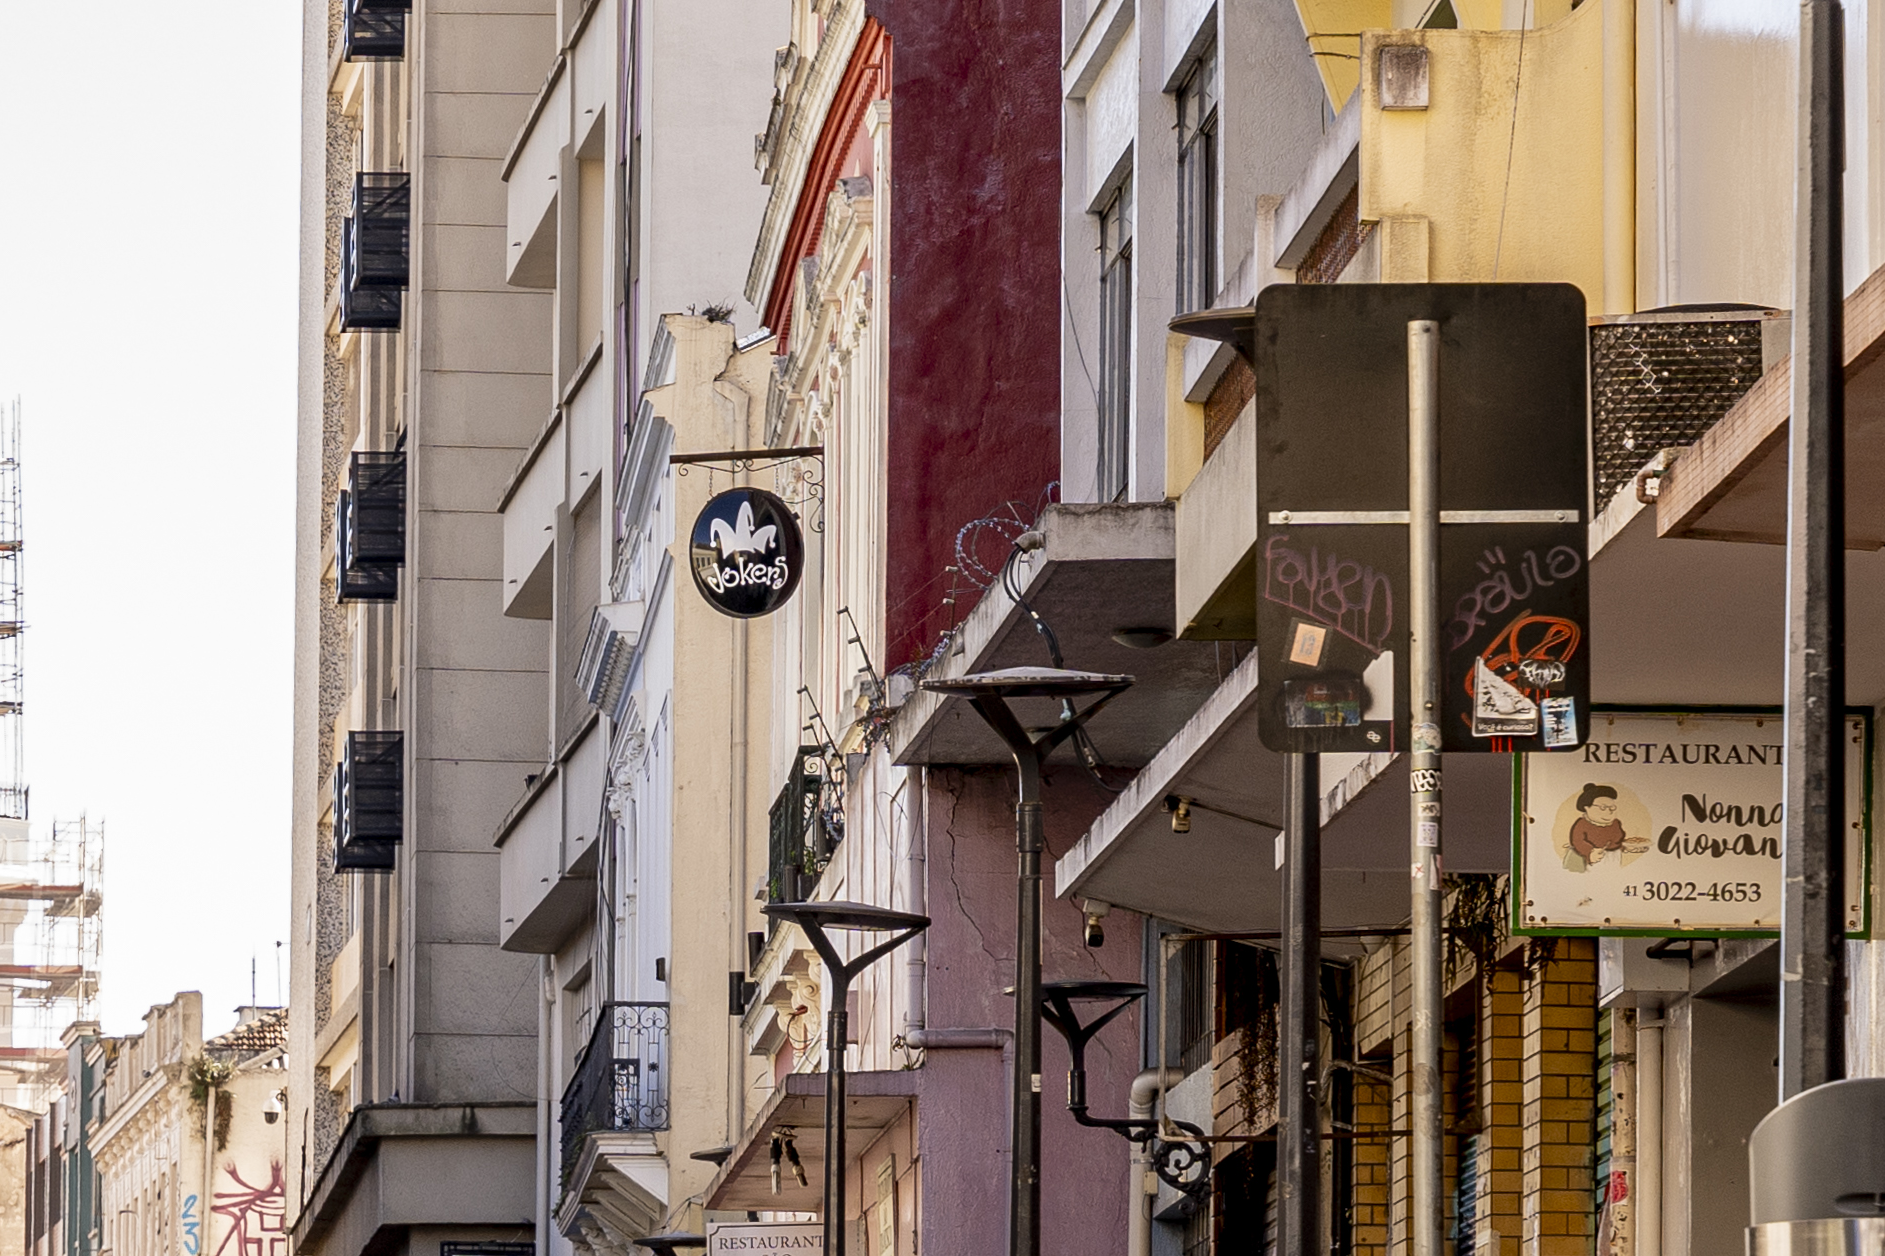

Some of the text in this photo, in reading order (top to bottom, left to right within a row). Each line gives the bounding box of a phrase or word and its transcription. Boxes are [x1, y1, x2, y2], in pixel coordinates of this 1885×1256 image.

[707, 556, 788, 593] Jokers
[1583, 742, 1783, 766] RESTAURANT
[1658, 826, 1783, 859] Giovan
[1623, 881, 1762, 903] 41 3022-4653
[719, 1236, 823, 1250] RESTAURANT
